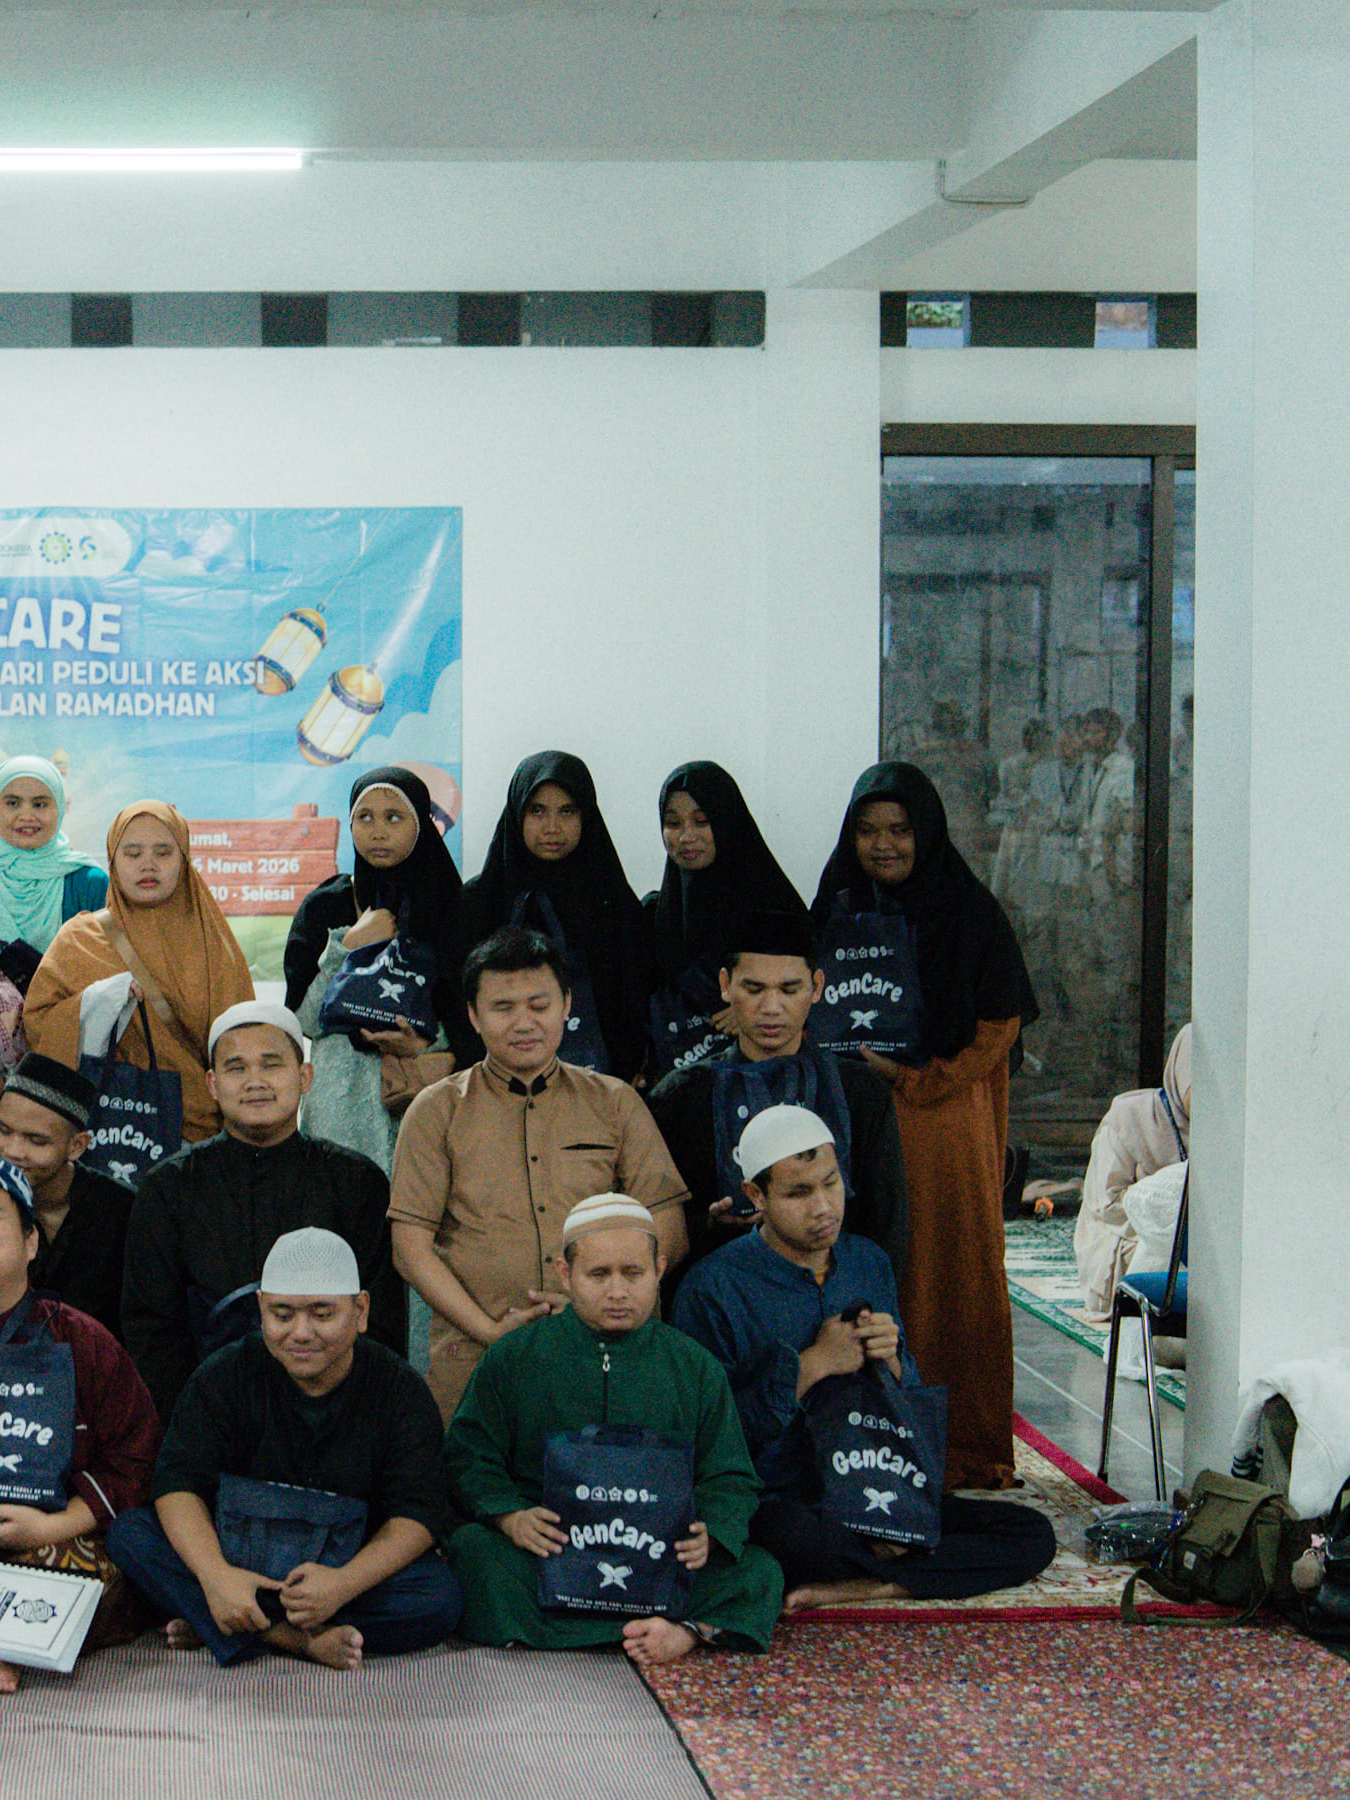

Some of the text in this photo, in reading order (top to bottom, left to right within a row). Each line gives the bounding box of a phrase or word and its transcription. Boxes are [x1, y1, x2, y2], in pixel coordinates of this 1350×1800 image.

[52, 660, 152, 685] PEDULI
[162, 660, 197, 685] KE
[204, 660, 266, 685] AKSI
[55, 692, 215, 717] RAMADHAN
[189, 831, 232, 848] umat,
[207, 857, 254, 875] Maret
[257, 857, 301, 875] 2026
[241, 885, 295, 902] Selesai
[824, 972, 903, 1005] GenCare
[832, 1446, 927, 1488] GenCare
[569, 1517, 667, 1560] GenCare
